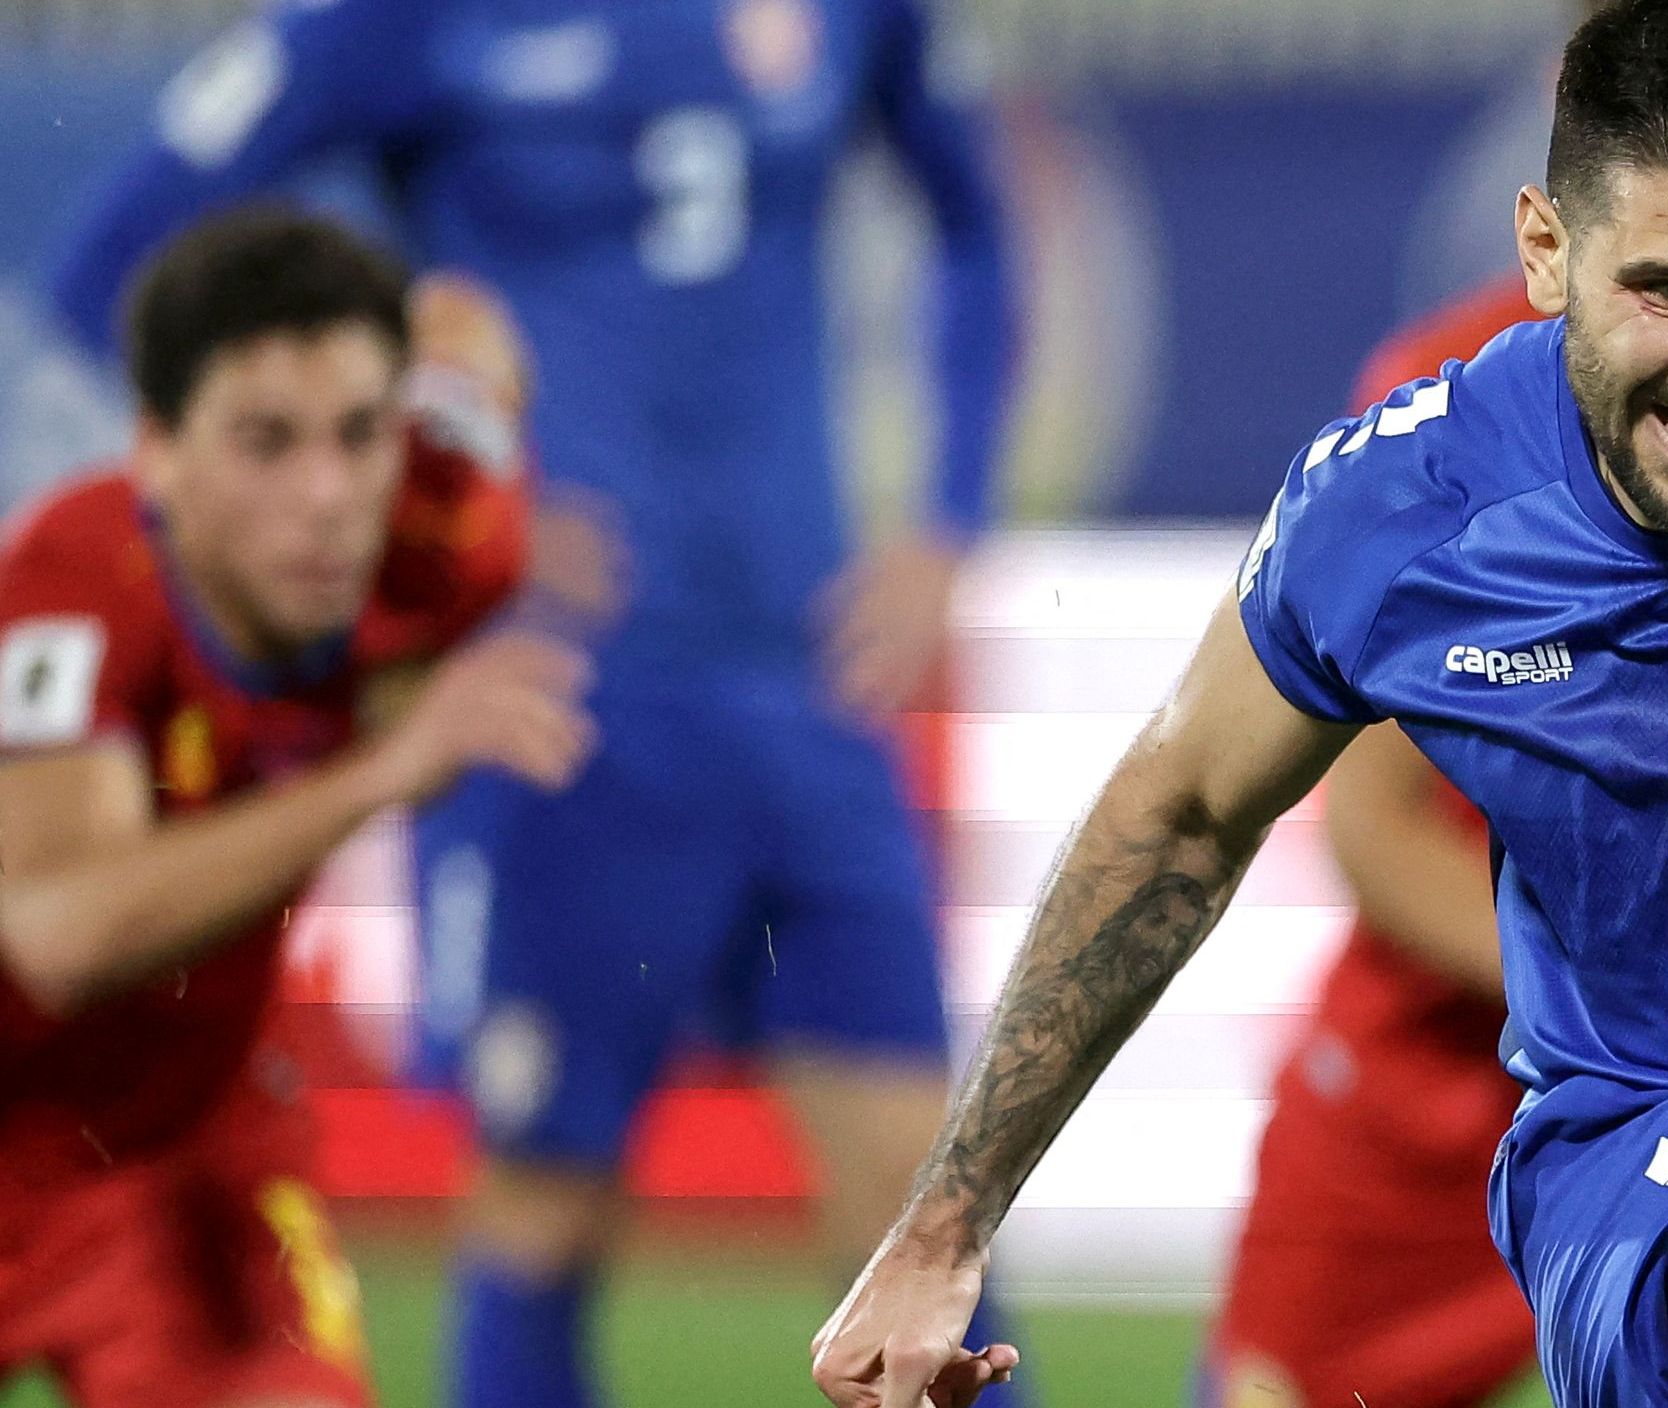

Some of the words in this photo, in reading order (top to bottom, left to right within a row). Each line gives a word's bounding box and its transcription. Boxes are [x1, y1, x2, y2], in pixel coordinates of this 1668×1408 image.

[635, 104, 752, 286] 3
[1445, 641, 1573, 683] capelli
[1500, 666, 1574, 685] SPORT
